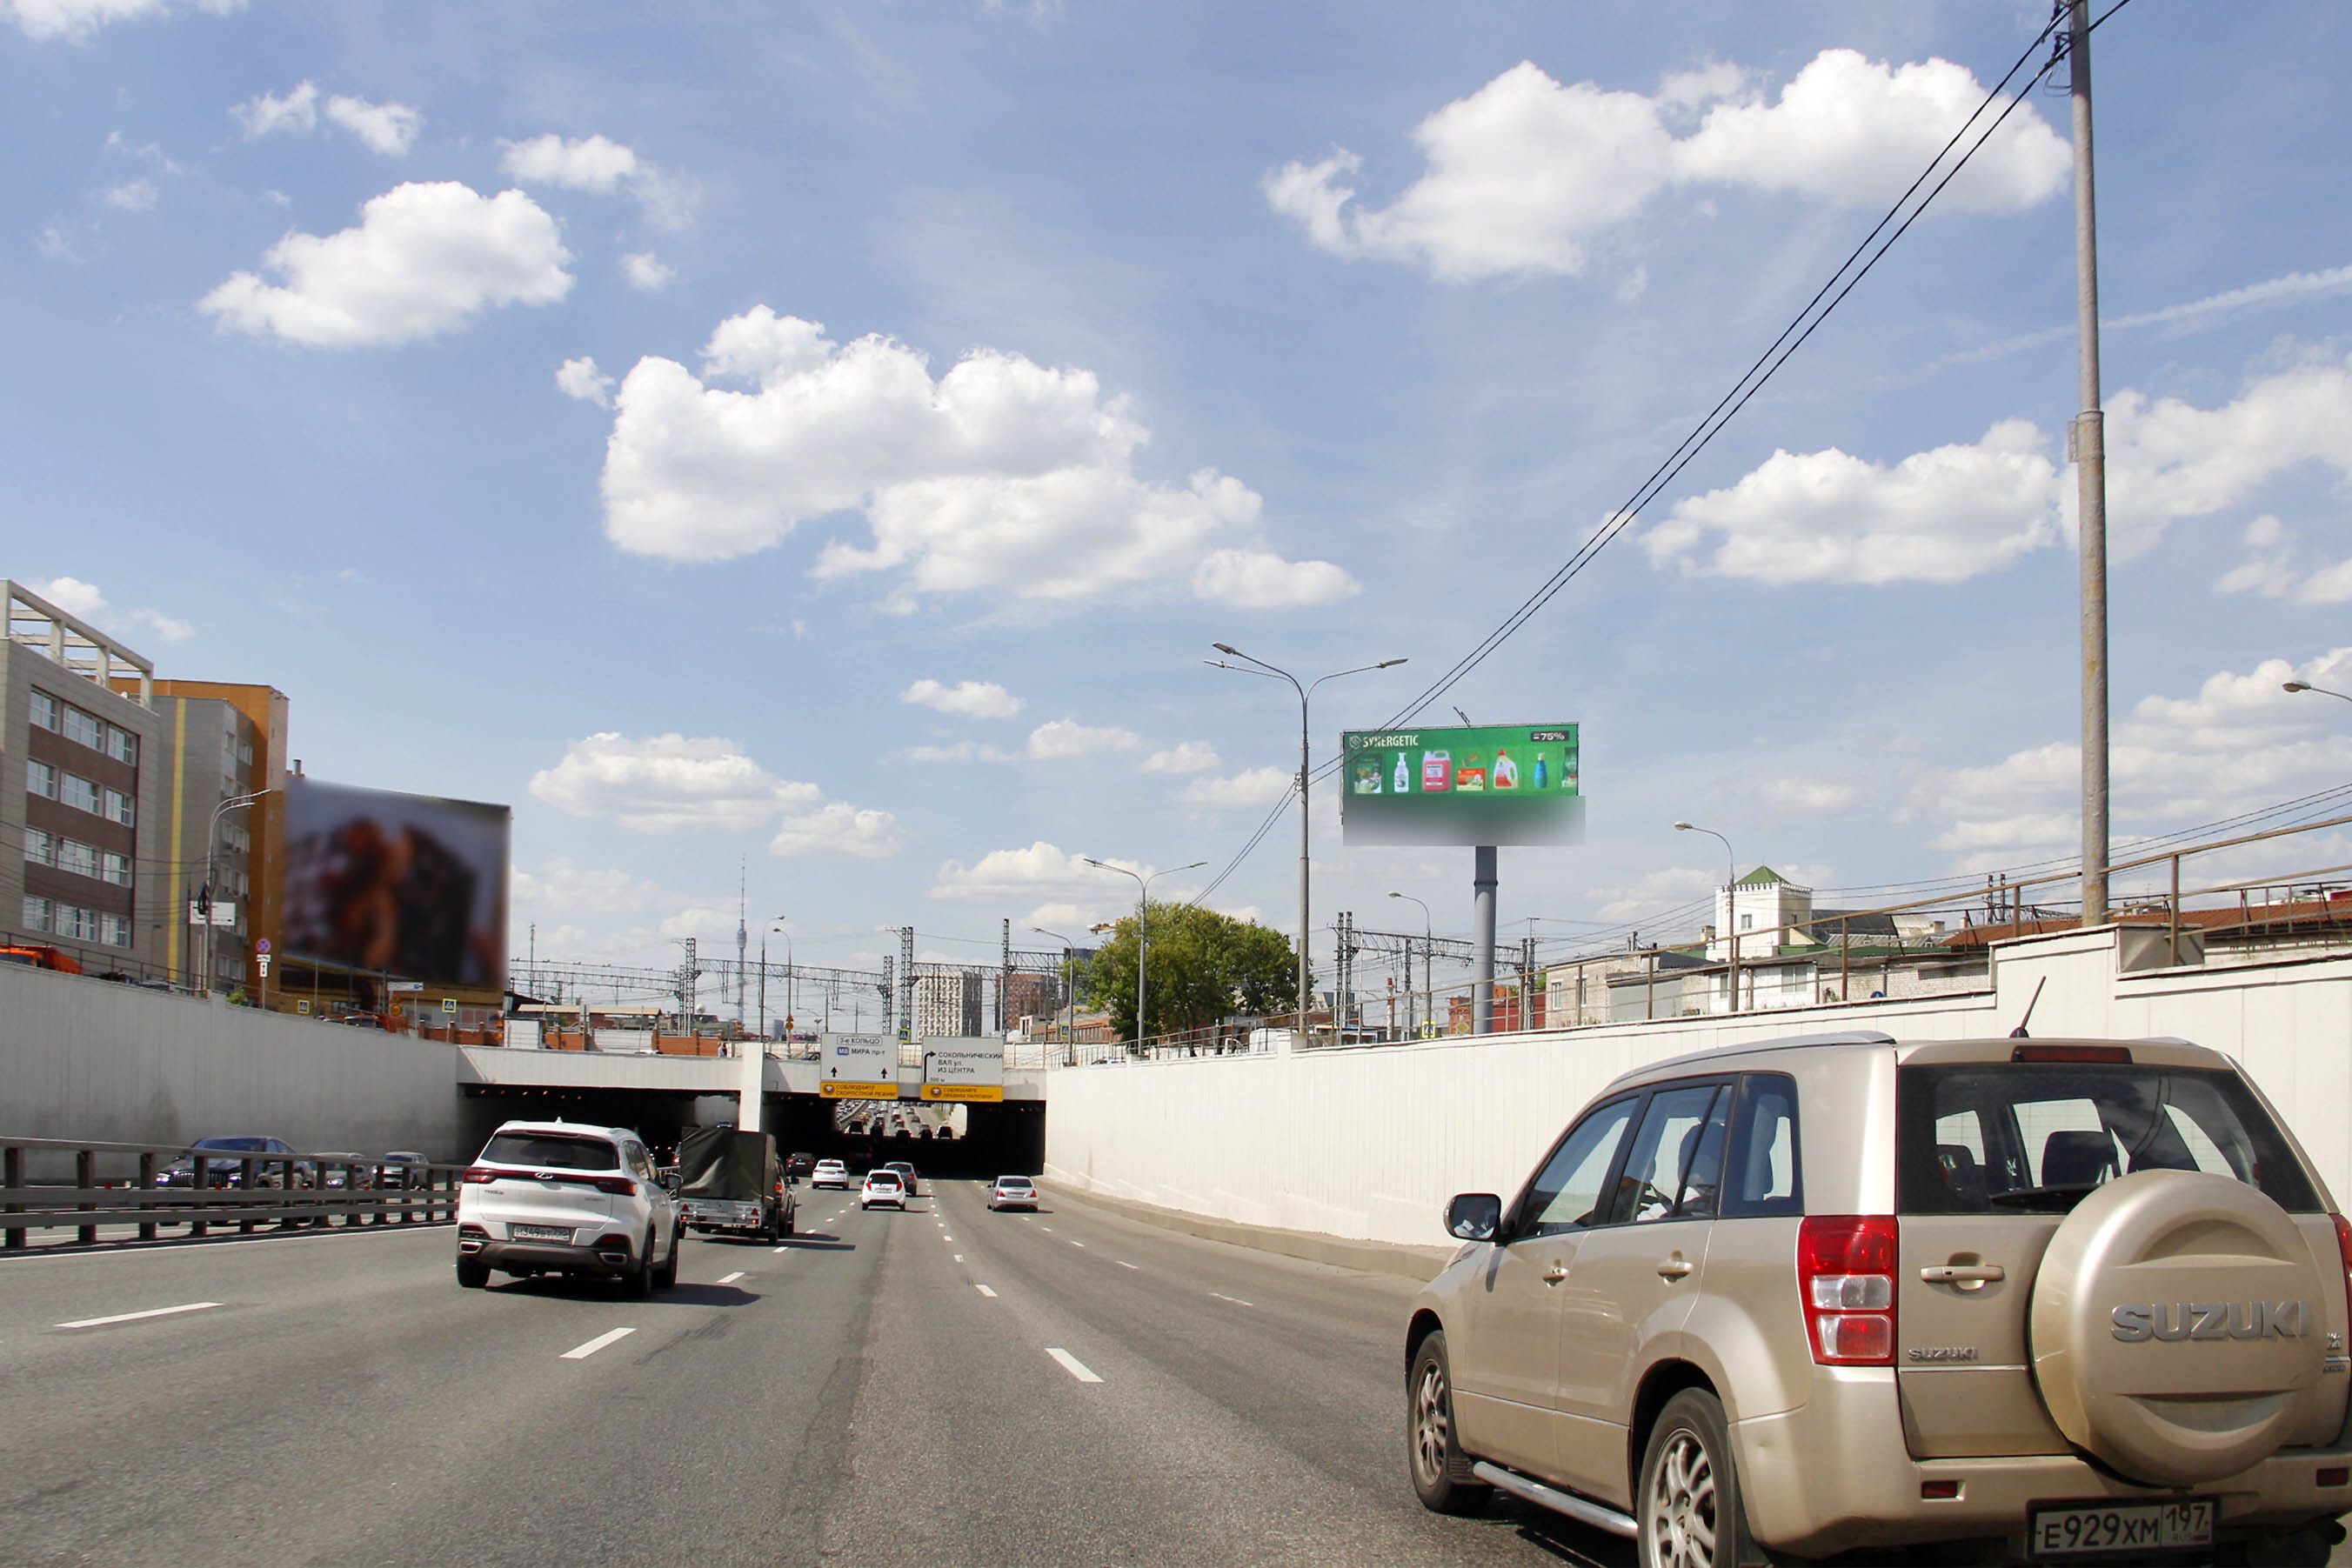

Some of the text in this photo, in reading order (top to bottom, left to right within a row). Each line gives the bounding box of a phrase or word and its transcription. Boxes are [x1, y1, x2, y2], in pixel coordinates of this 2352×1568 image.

[1363, 734, 1419, 748] SYNERGETIC
[2111, 1301, 2310, 1341] SUZUKI
[1908, 1347, 1979, 1362] SUZUKI
[2165, 1505, 2207, 1531] 197
[2172, 1532, 2193, 1543] RUS
